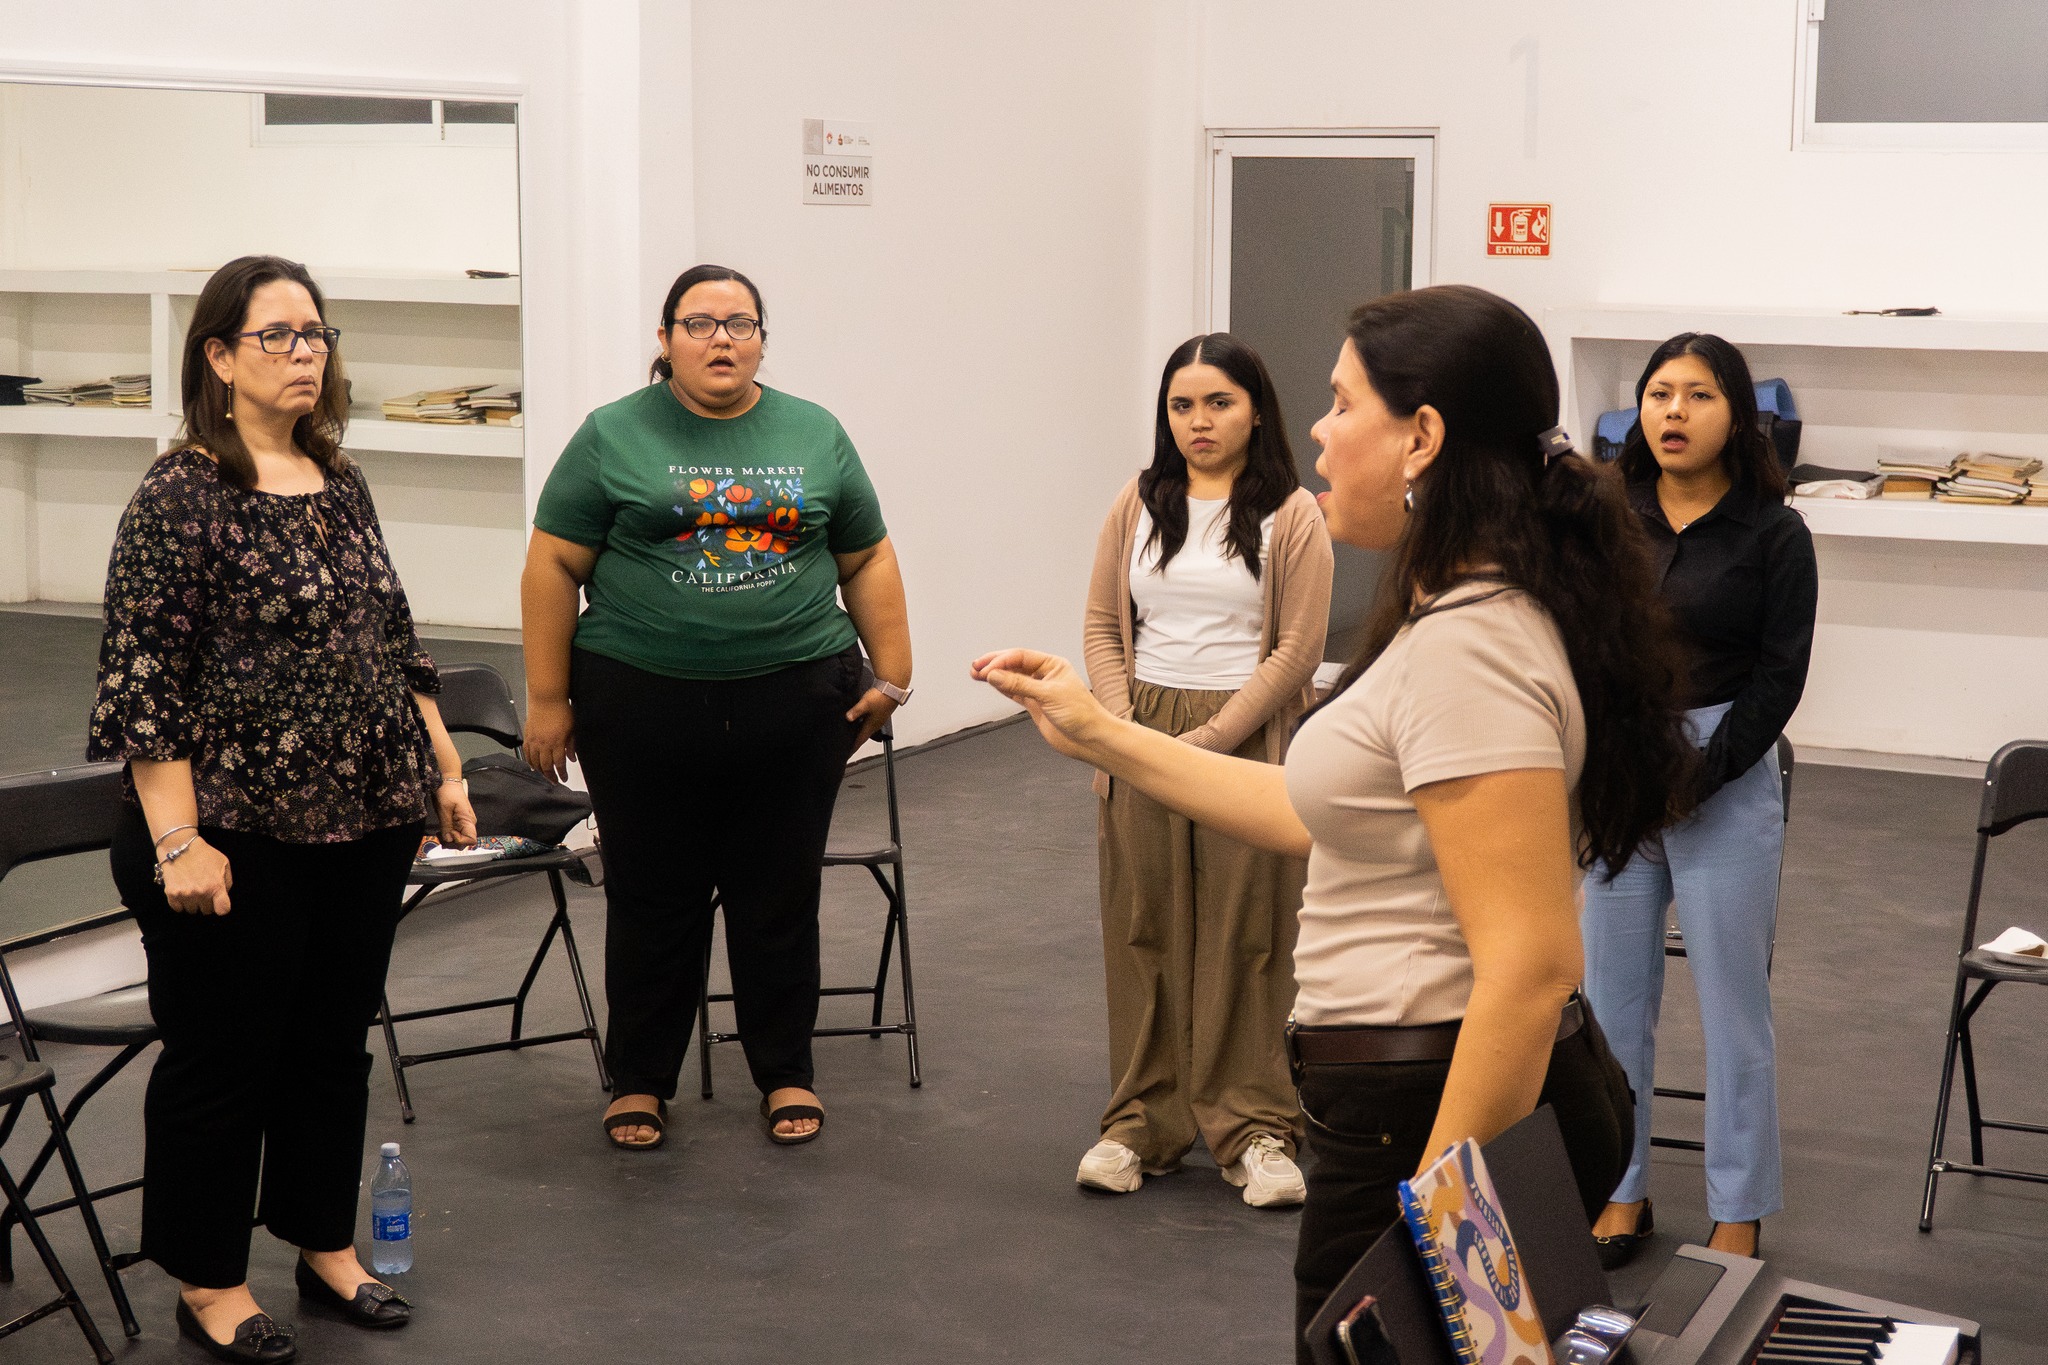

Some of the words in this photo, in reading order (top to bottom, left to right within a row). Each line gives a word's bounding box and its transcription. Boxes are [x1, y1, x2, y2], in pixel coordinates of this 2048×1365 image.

[806, 164, 820, 176] NO
[822, 165, 869, 178] CONSUMIR
[812, 182, 864, 196] ALIMENTOS
[1495, 245, 1541, 254] EXTINTOR
[669, 465, 735, 476] FLOWER
[742, 466, 805, 476] MARKET
[671, 561, 797, 584] CALIFORNIA
[715, 583, 755, 593] CALIFORNIA
[756, 579, 776, 588] POPPY
